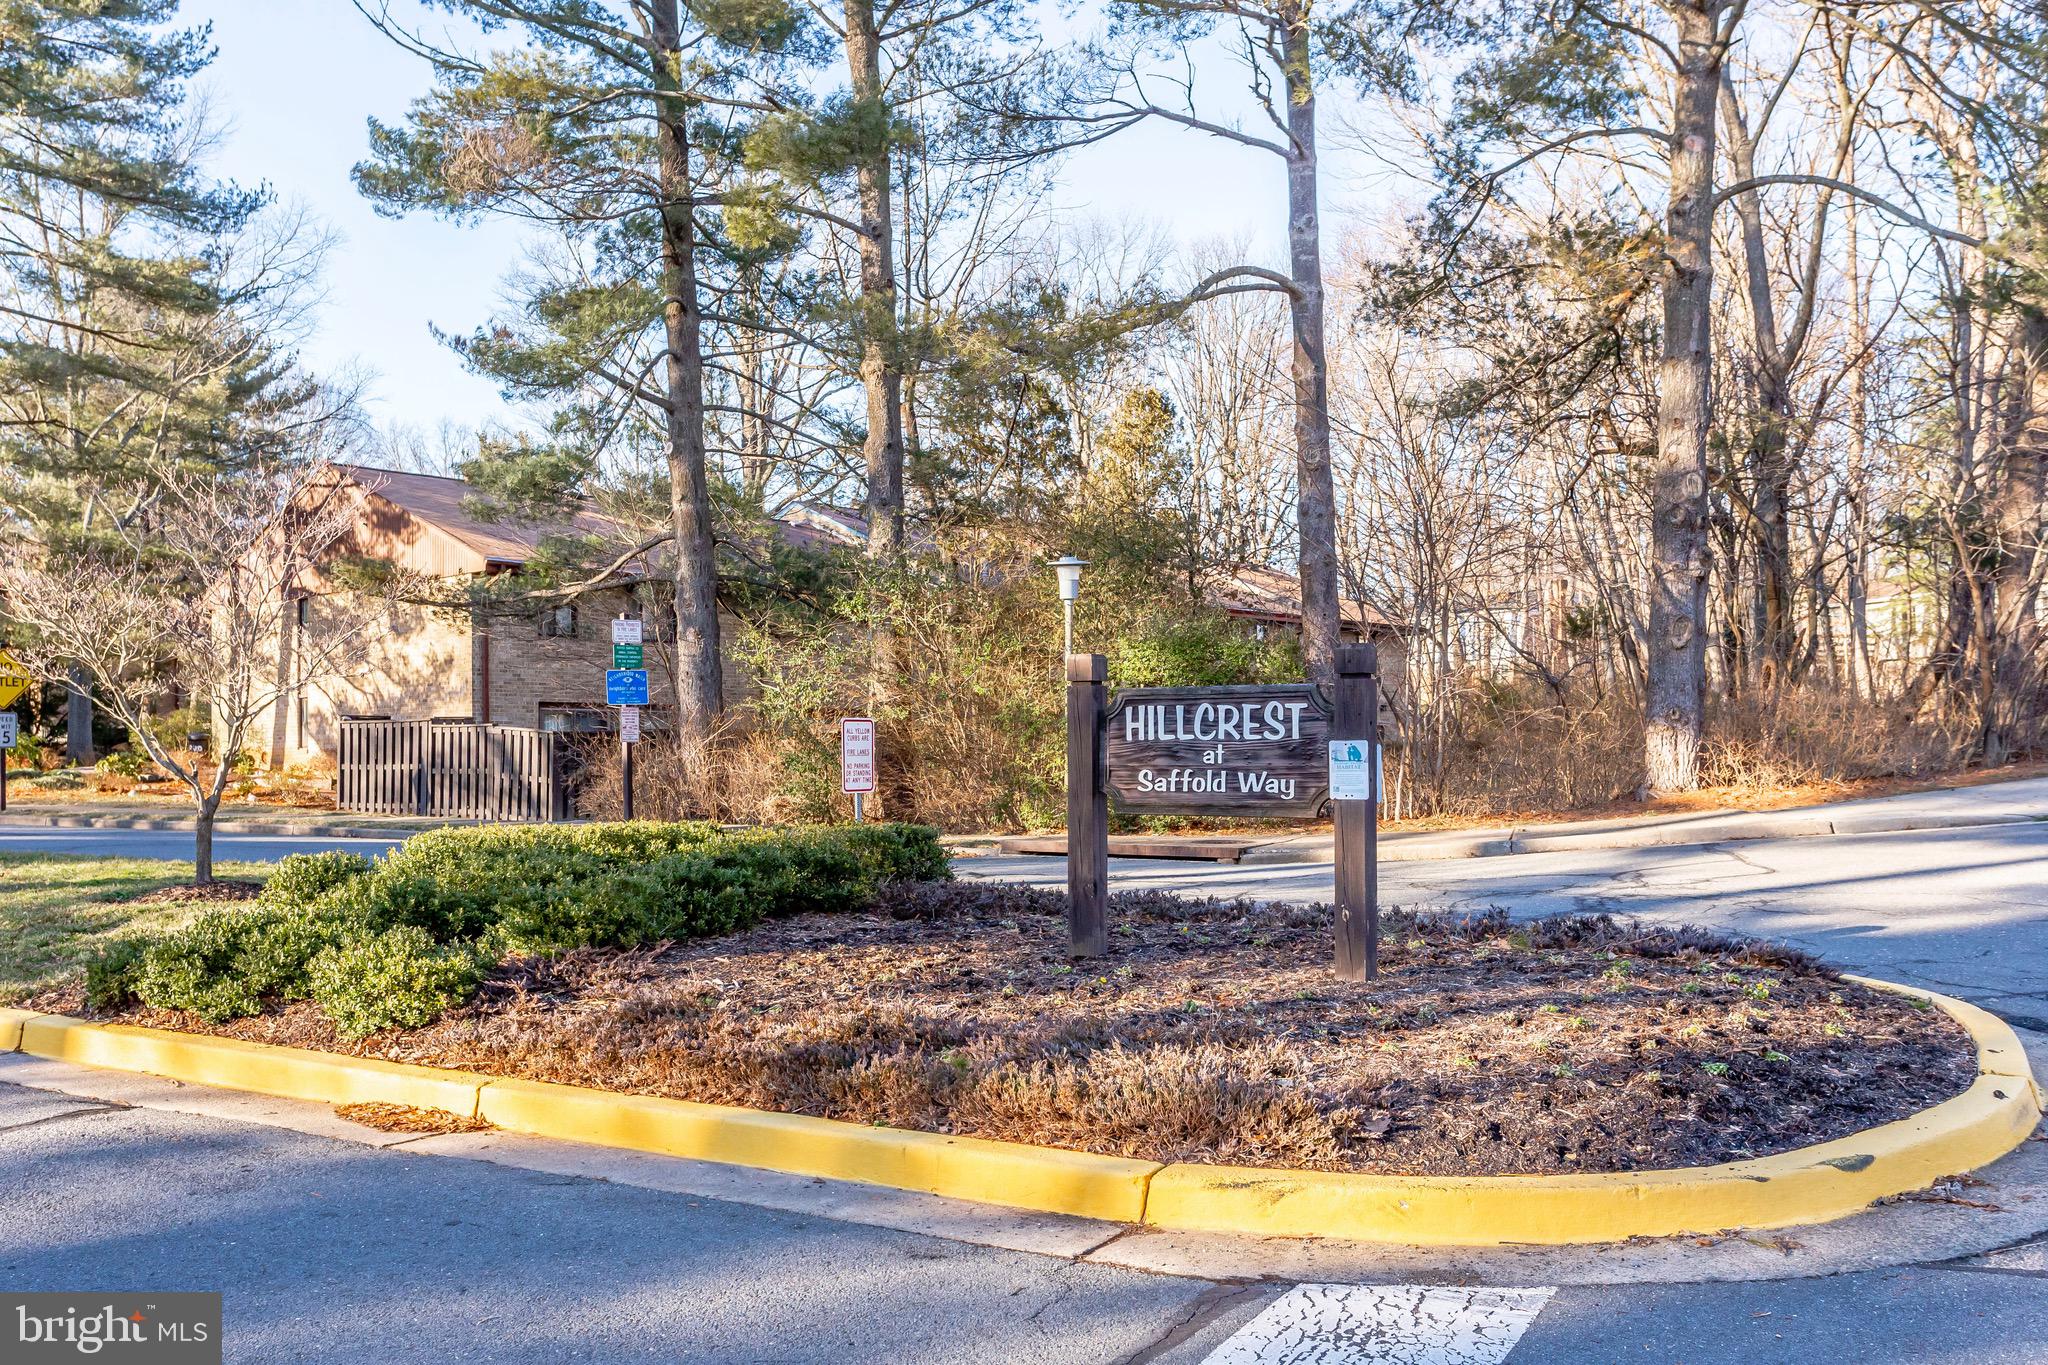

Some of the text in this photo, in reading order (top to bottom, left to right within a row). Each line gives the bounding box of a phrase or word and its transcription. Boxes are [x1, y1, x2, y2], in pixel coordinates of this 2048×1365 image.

[1125, 700, 1309, 741] HILLCREST
[1202, 744, 1225, 764] at
[1137, 768, 1296, 800] Saffold Way
